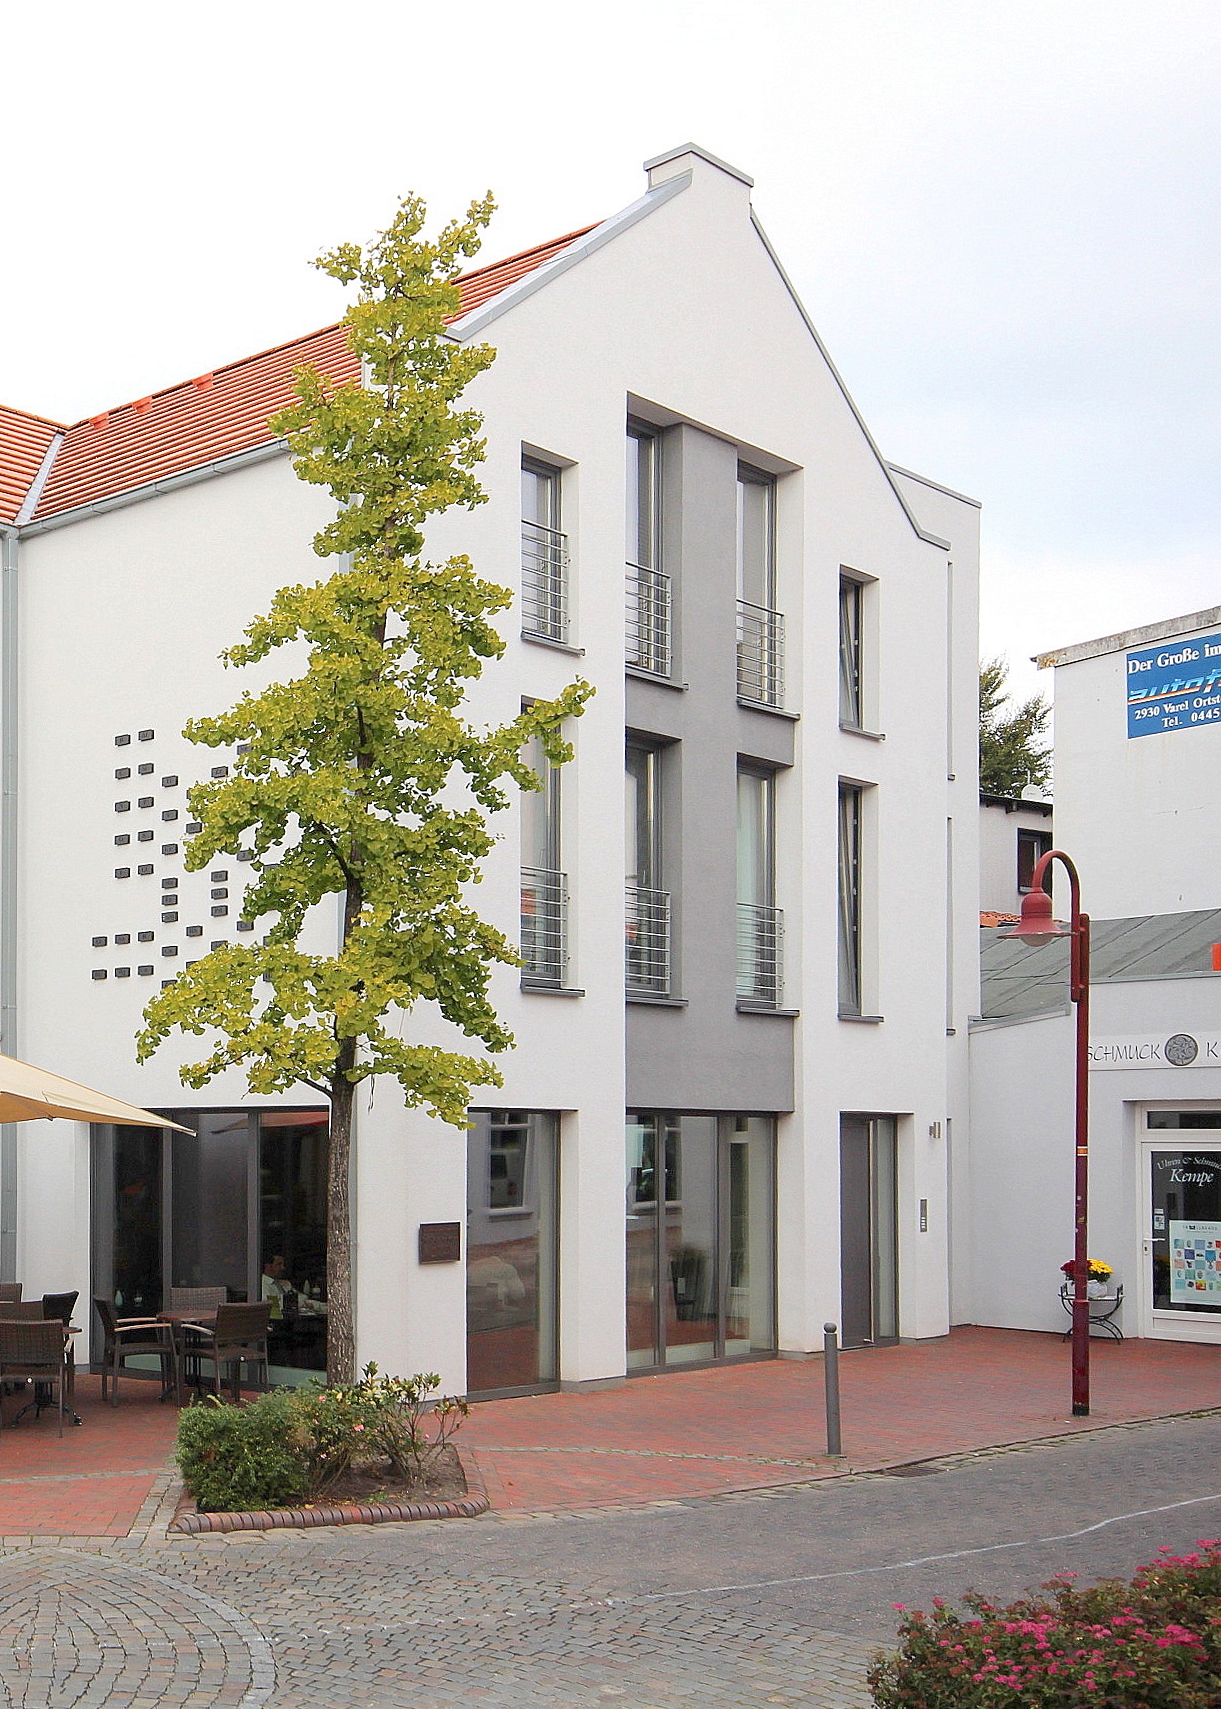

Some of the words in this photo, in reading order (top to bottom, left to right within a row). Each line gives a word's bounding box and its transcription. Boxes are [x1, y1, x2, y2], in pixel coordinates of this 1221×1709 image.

[1128, 660, 1153, 674] Der
[1157, 648, 1199, 667] Große
[1135, 706, 1160, 720] 2930
[1163, 701, 1189, 714] Varel
[1162, 716, 1183, 728] Tel.
[1191, 708, 1220, 722] 0445
[1088, 1044, 1160, 1062] SCHMUCK
[1157, 1160, 1181, 1170] Uhren
[1169, 1168, 1214, 1187] Kempe
